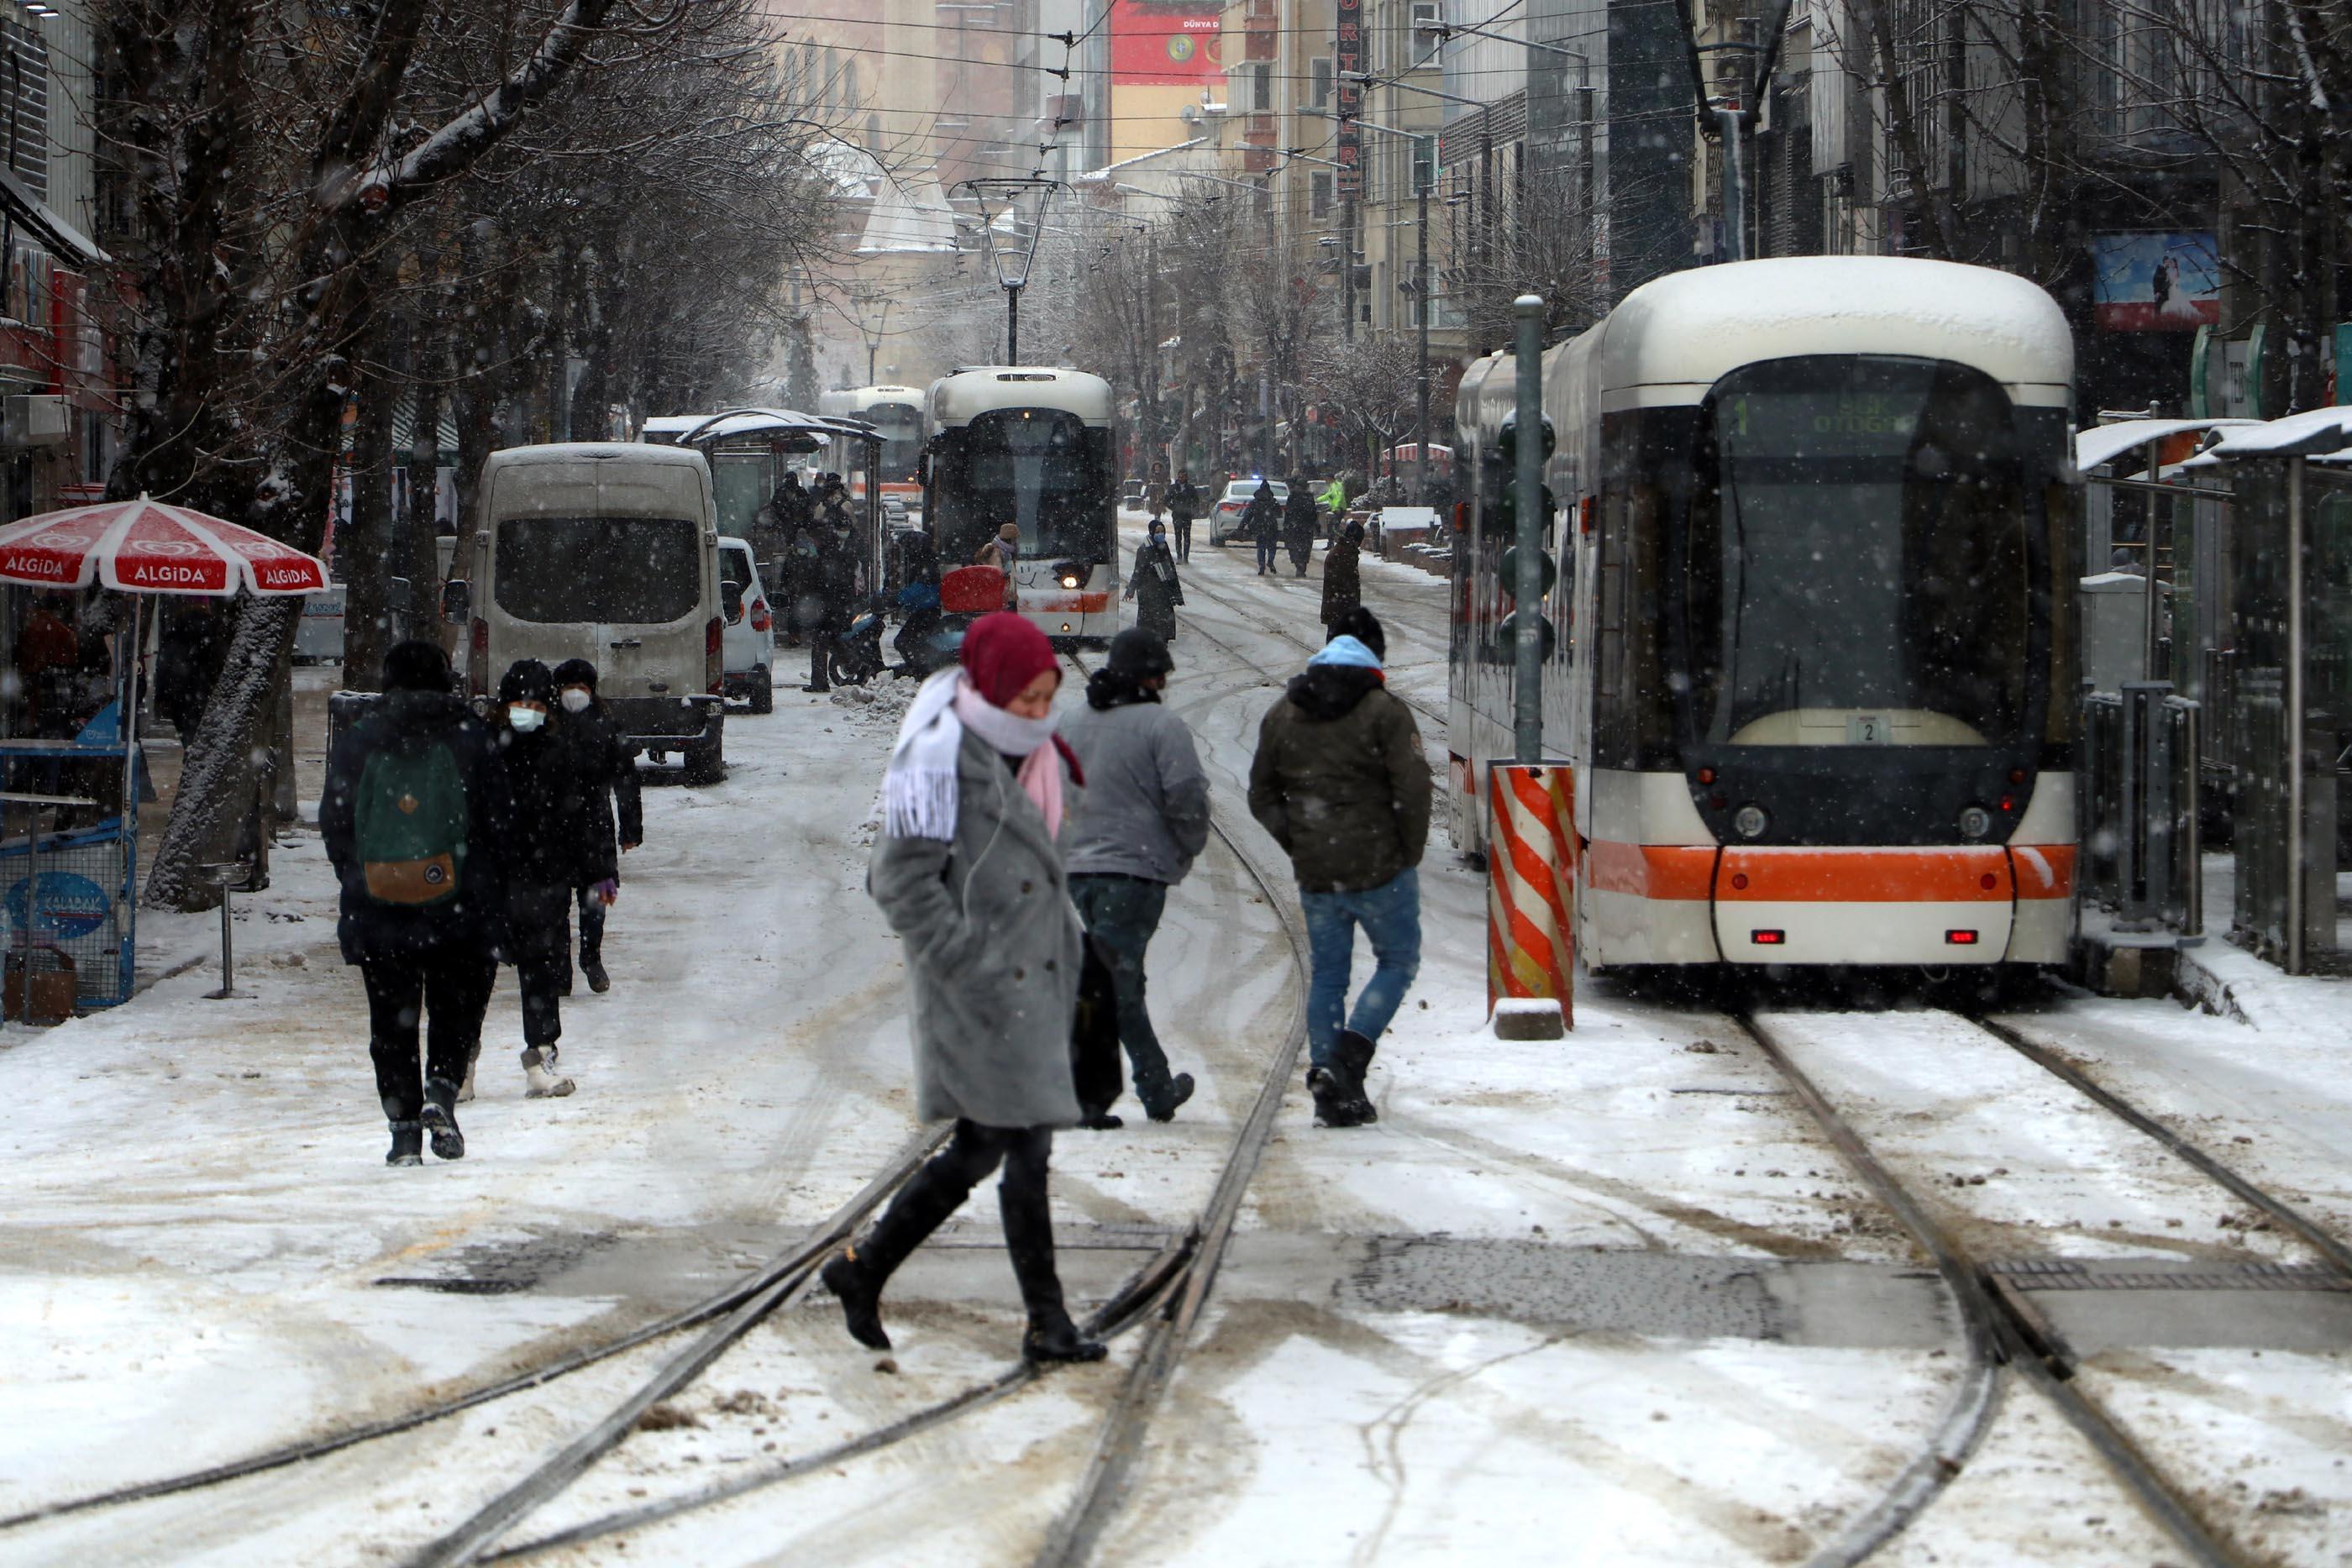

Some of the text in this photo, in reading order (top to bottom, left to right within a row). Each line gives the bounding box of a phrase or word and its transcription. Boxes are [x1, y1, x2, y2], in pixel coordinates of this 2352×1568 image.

[1184, 19, 1211, 28] DÜNYA
[1734, 398, 1746, 436] 1
[1865, 724, 1873, 741] 2
